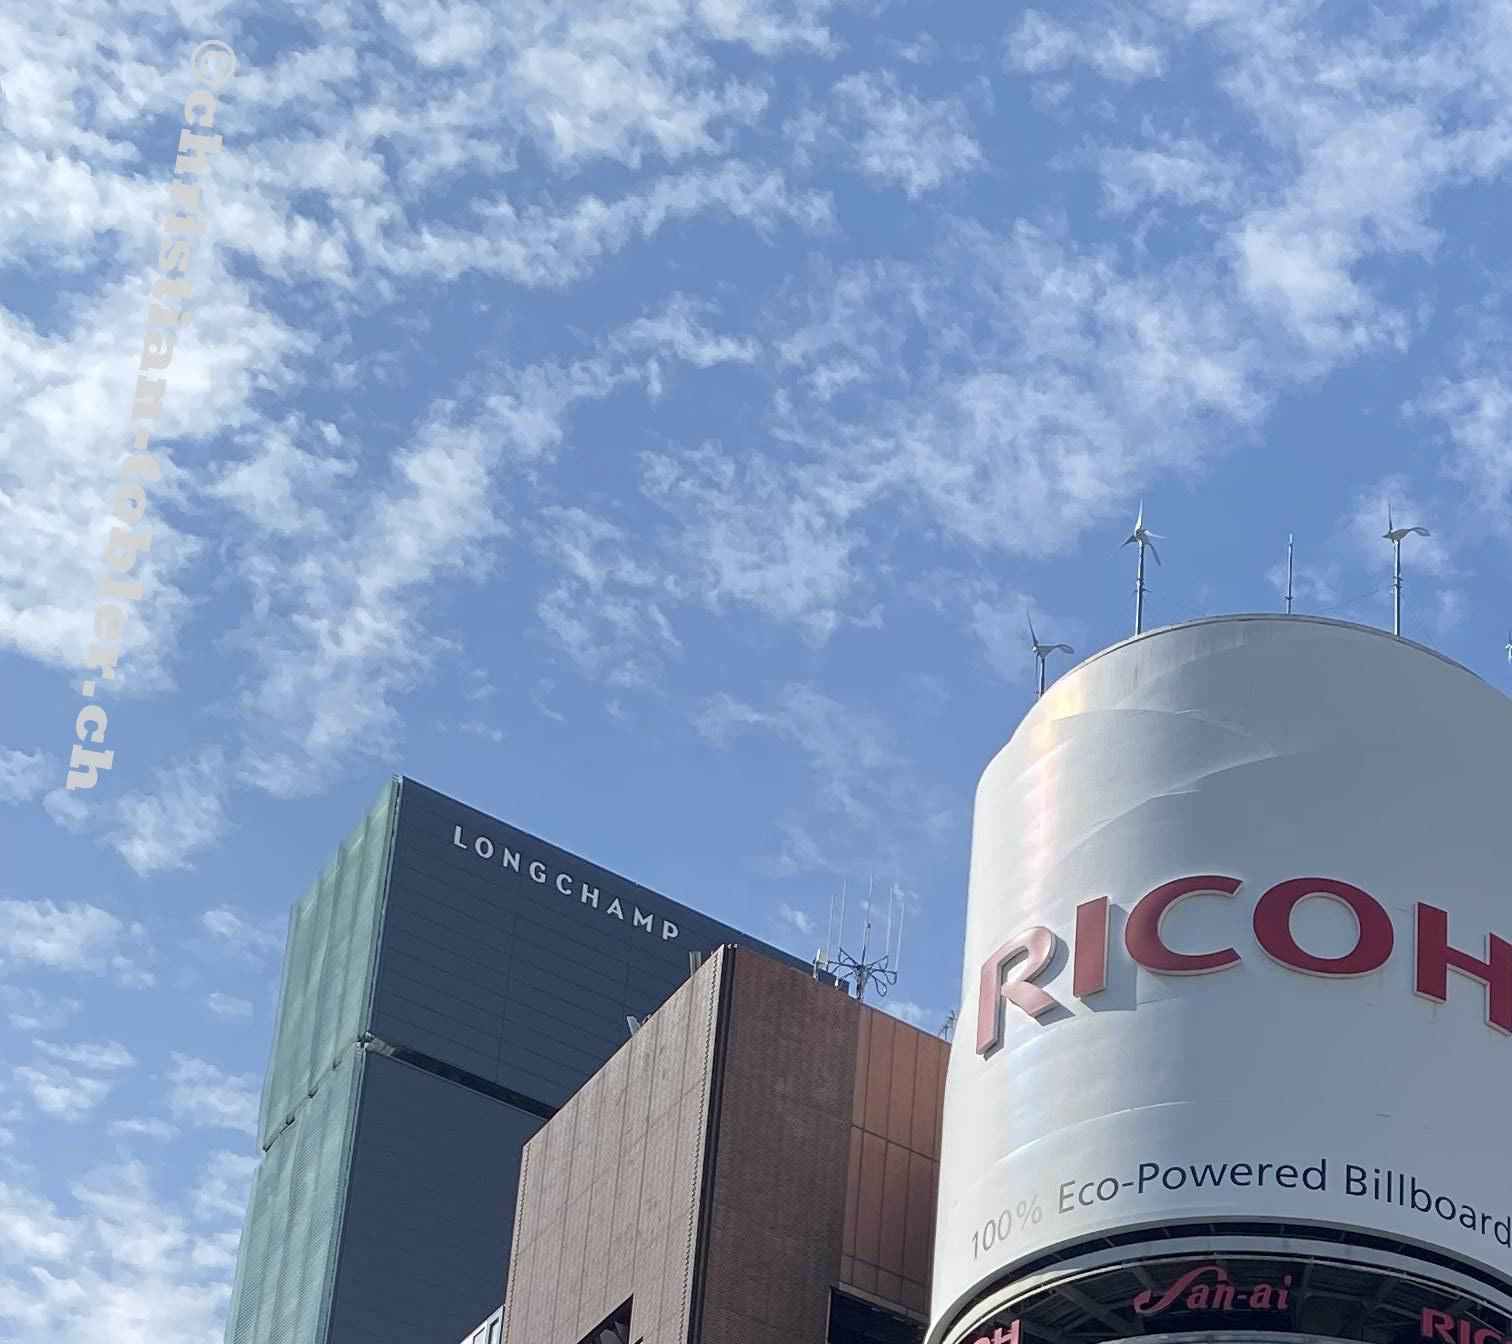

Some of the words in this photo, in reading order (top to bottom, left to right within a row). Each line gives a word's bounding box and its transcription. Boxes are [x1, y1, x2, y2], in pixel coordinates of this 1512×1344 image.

[453, 825, 679, 940] LONGCHAMP
[971, 1189, 1043, 1261] 100%
[1057, 1158, 1327, 1216] Eco-Powered
[1133, 1265, 1292, 1317] San-ai
